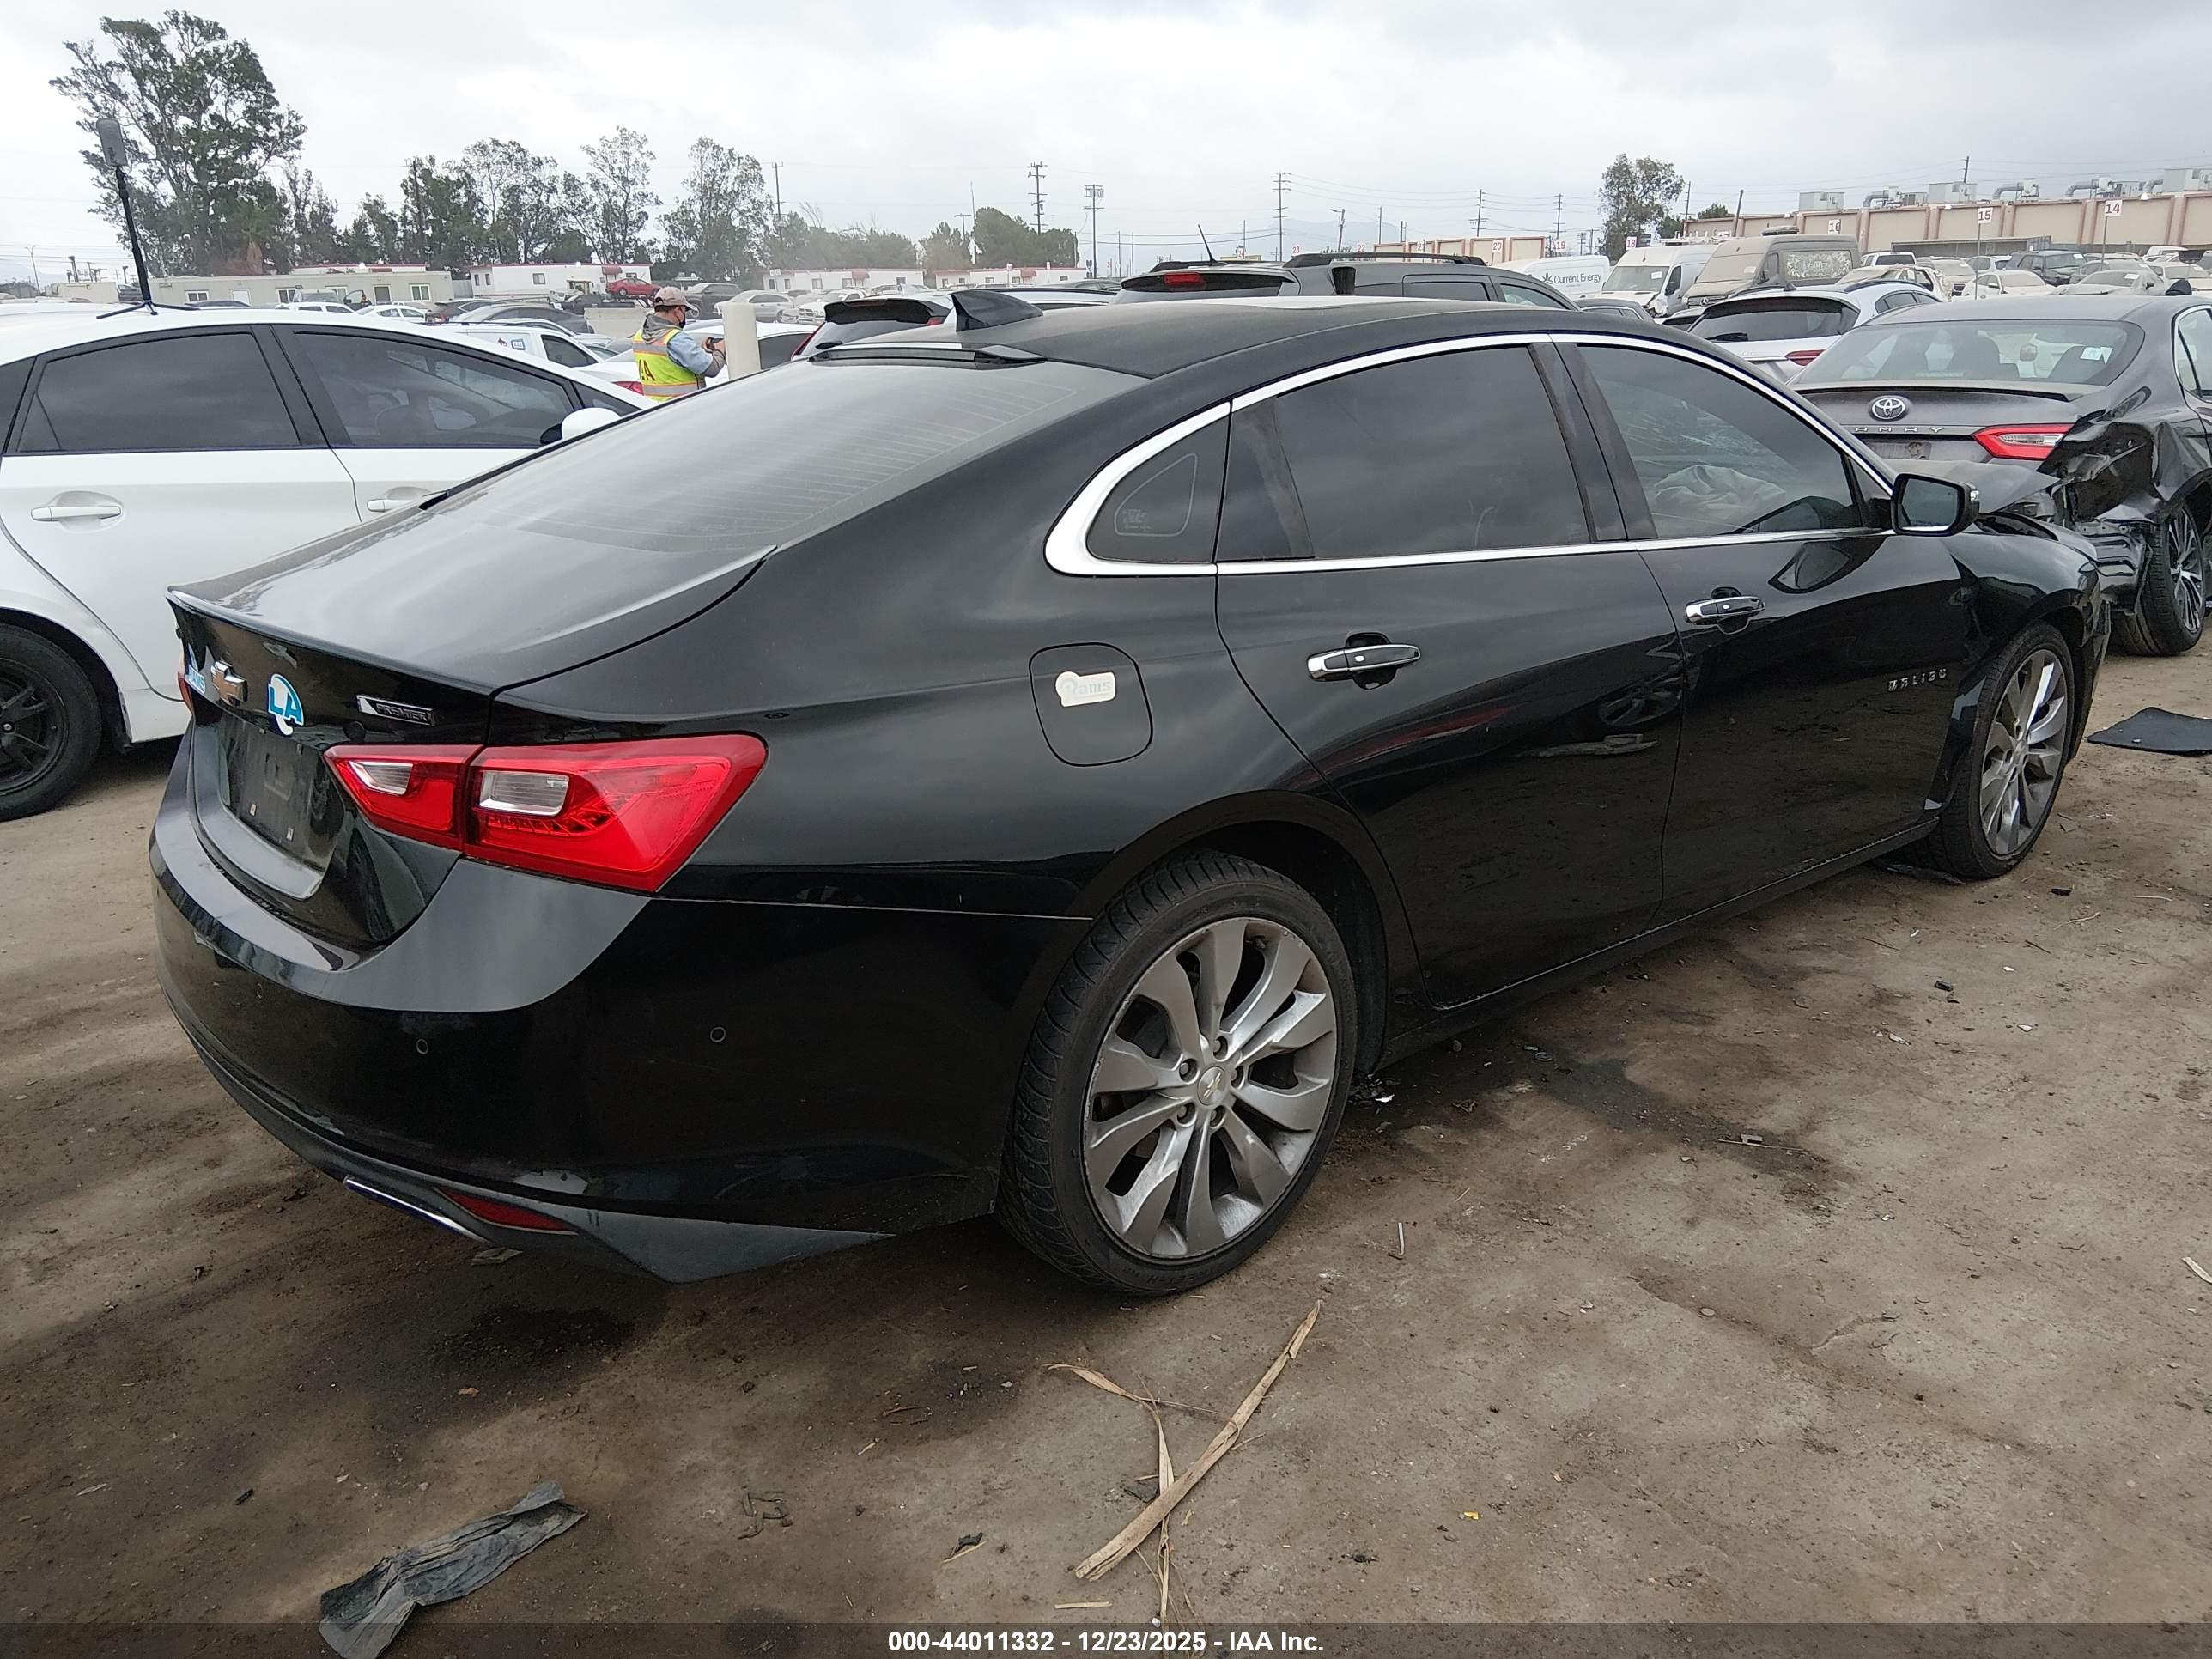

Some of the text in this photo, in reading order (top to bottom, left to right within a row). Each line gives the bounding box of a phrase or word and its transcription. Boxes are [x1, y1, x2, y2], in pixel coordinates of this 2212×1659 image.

[2106, 203, 2120, 214] 14
[1978, 210, 1991, 221] 15
[1626, 239, 1636, 248] 18
[1554, 273, 1602, 284] Current Energy
[376, 703, 428, 722] PREMIER
